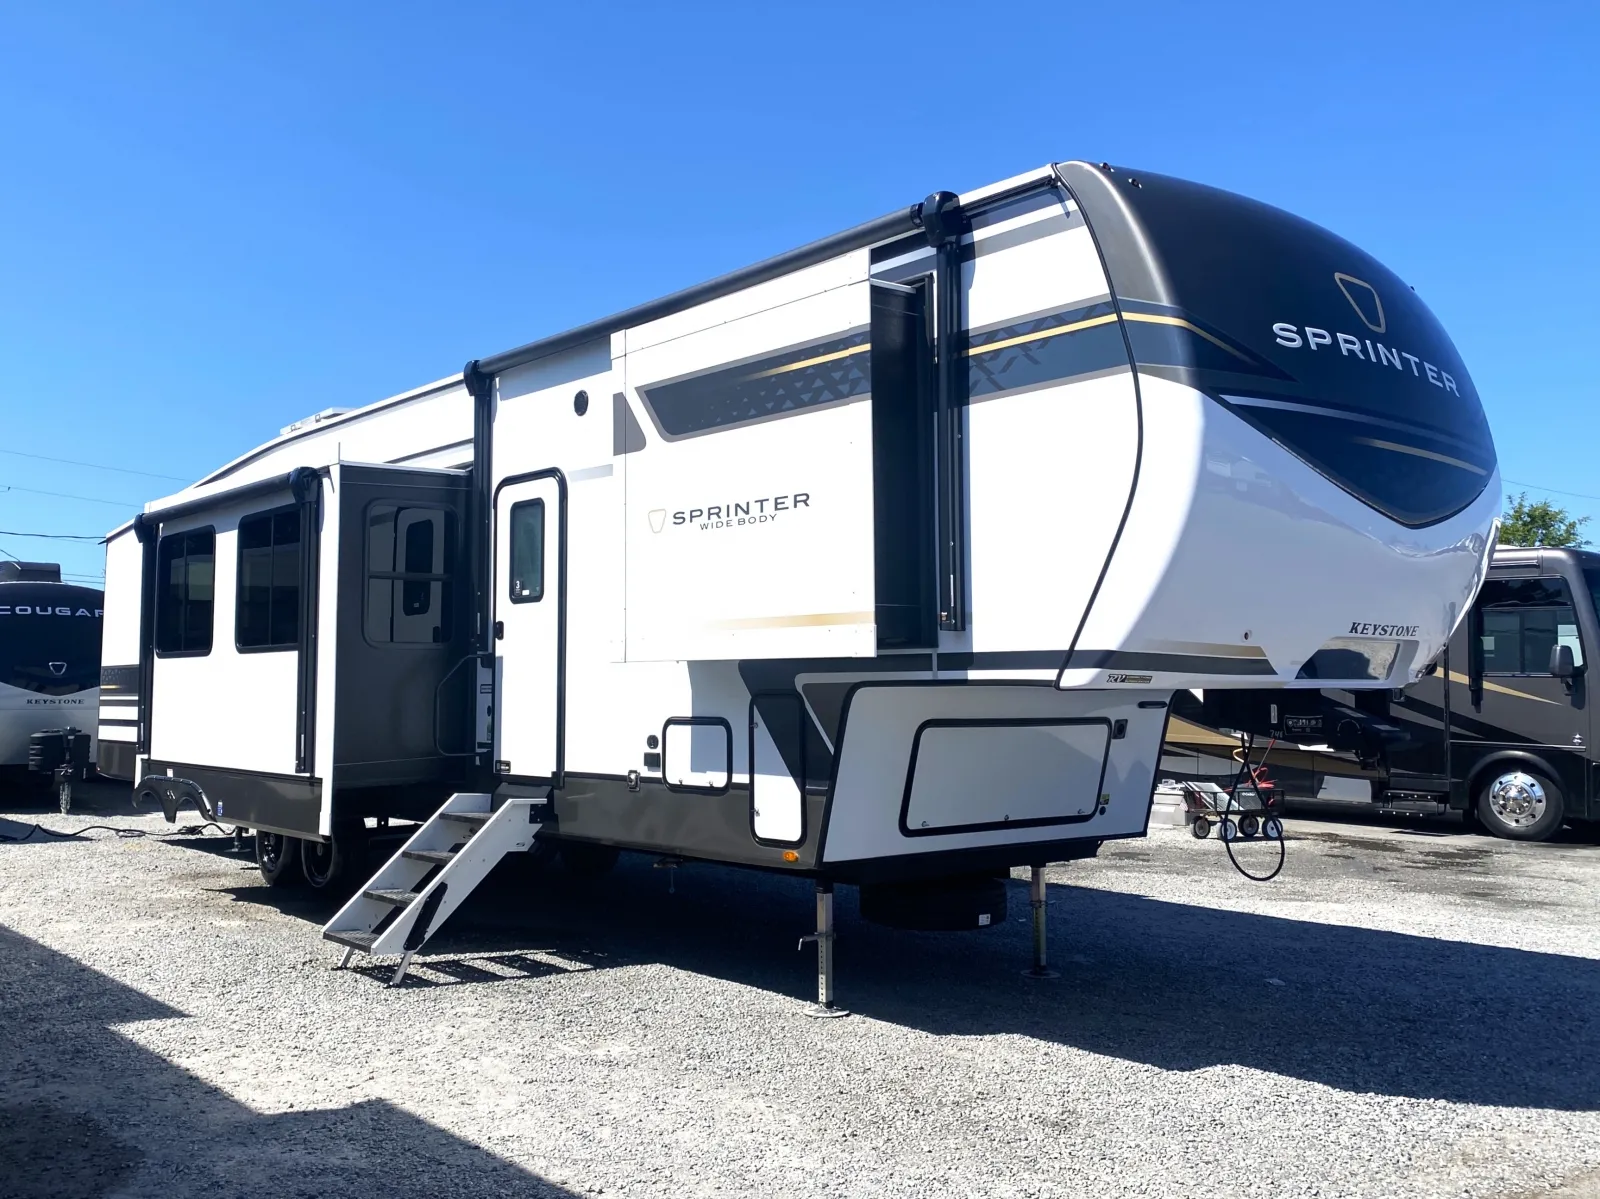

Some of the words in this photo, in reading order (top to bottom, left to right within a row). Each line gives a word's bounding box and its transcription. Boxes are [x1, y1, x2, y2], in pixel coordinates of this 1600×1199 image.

[1272, 322, 1460, 398] SPRINTER
[672, 492, 810, 525] SPRINTER
[1348, 621, 1419, 637] KEYSTONE
